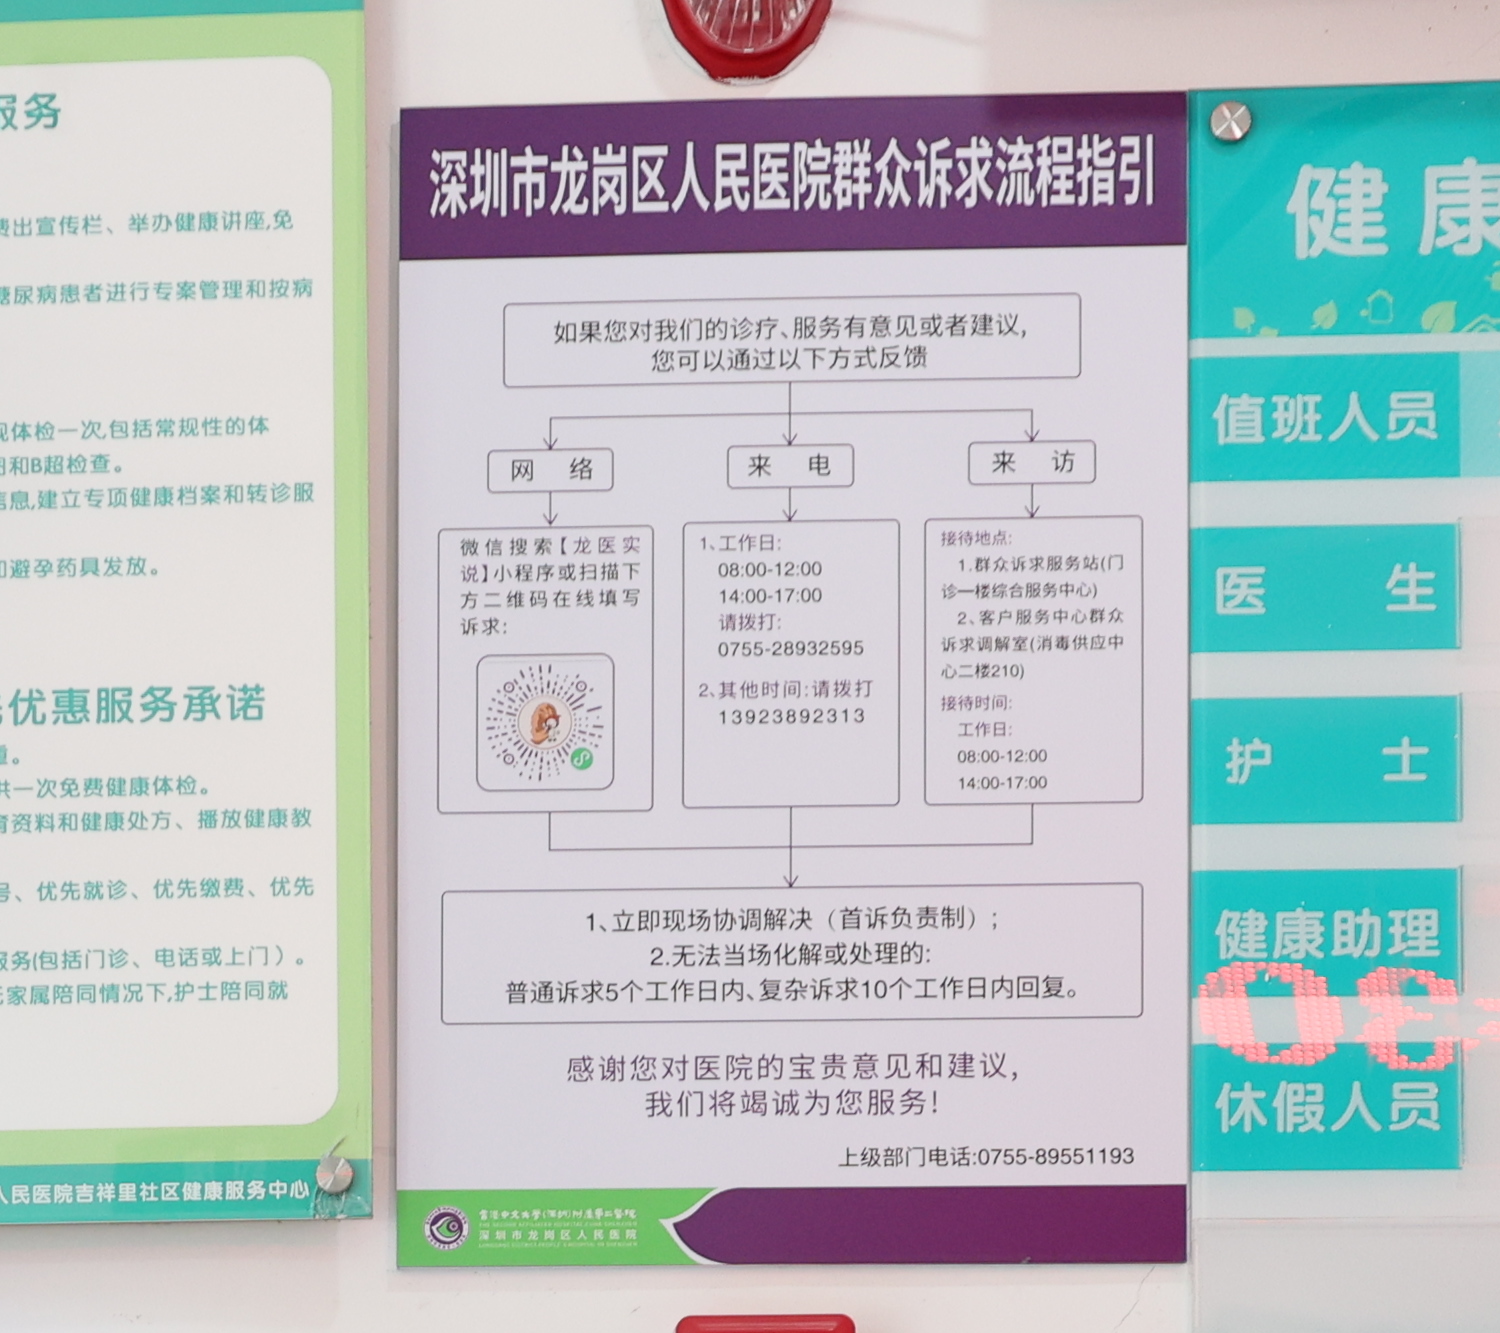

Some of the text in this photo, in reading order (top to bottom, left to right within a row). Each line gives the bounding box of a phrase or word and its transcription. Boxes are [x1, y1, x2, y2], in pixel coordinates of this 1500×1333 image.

[429, 132, 1156, 219] 深圳市龙岗区人民医院群众诉求流程指引
[650, 344, 928, 373] 您可以通过以下方式反馈
[1213, 391, 1438, 445] 值班人员
[718, 561, 822, 578] 08:00-12:00
[460, 588, 640, 609] 方二维码在线填写
[718, 587, 822, 604] 14:00-17:00
[718, 639, 864, 658] 0755-28932595
[719, 707, 865, 725] 13923892313
[957, 748, 1048, 764] 08:00-12:00
[957, 775, 1048, 790] 14:00-17:00
[1215, 907, 1441, 960] 健康助理
[1215, 1079, 1441, 1134] 休假人员
[479, 1229, 638, 1240] 深圳市龙岗区人民医院
